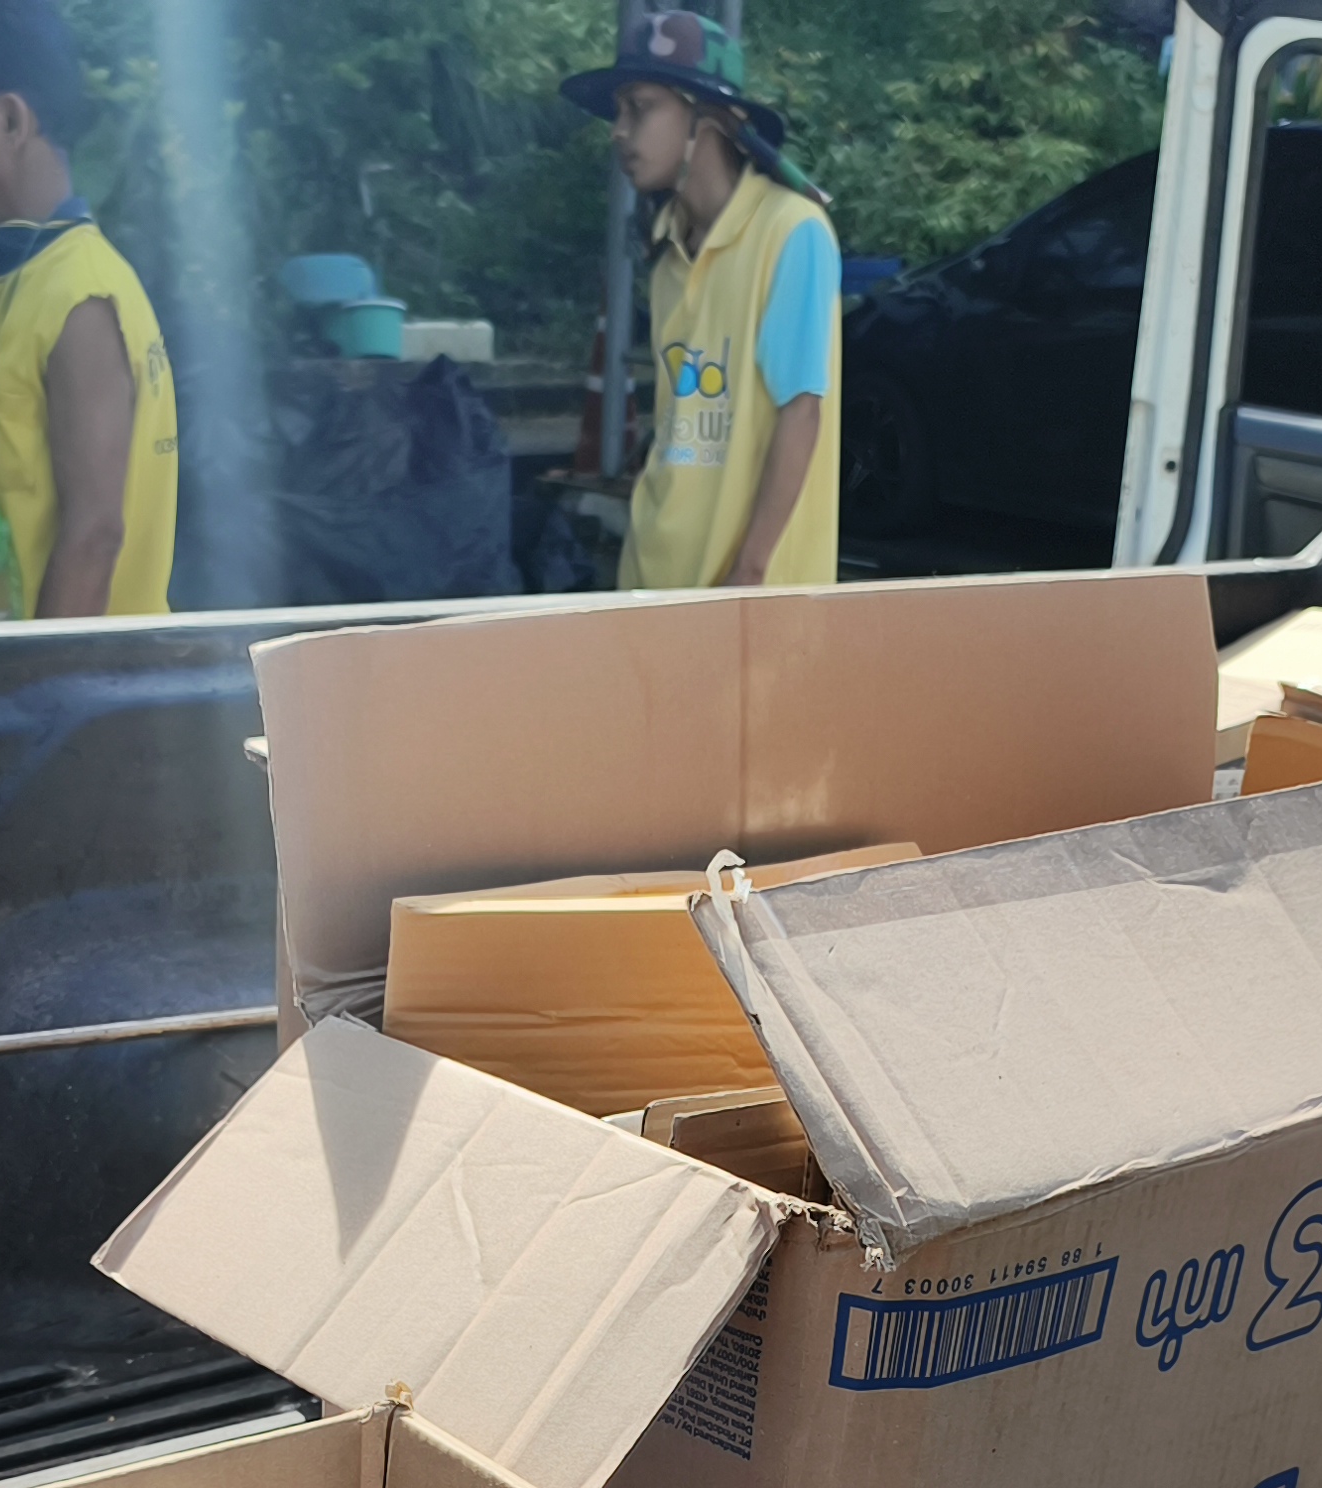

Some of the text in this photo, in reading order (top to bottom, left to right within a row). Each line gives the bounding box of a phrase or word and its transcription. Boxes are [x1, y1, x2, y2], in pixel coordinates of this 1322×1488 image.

[871, 1241, 1102, 1295] 1 88 59411 30003 7
[1136, 1244, 1244, 1371] เท่า
